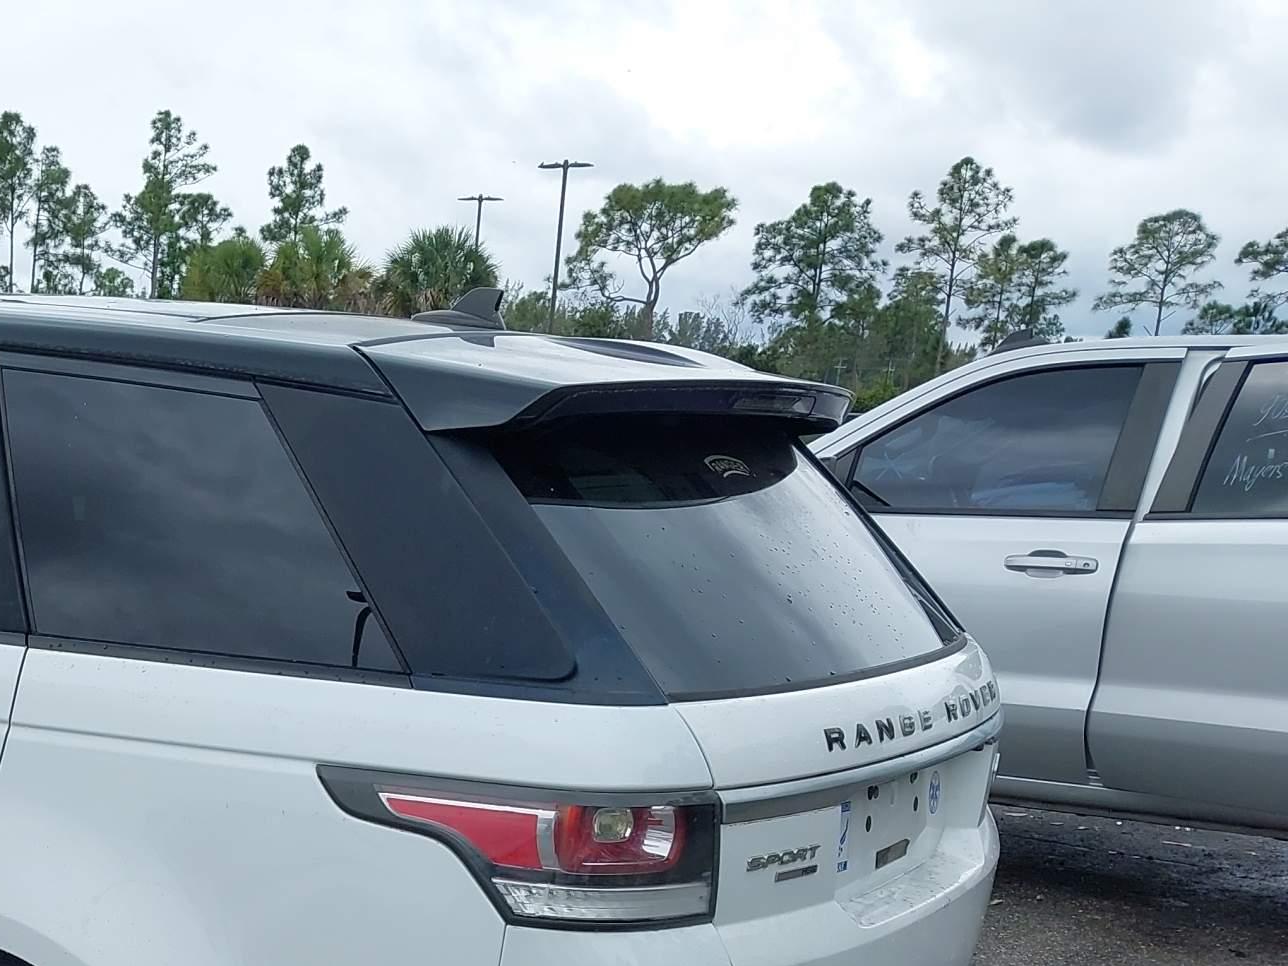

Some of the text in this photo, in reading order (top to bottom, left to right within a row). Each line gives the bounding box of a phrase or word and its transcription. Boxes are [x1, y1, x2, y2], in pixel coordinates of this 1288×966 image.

[823, 680, 997, 752] RANGE ROVER
[746, 844, 822, 872] SPORT
